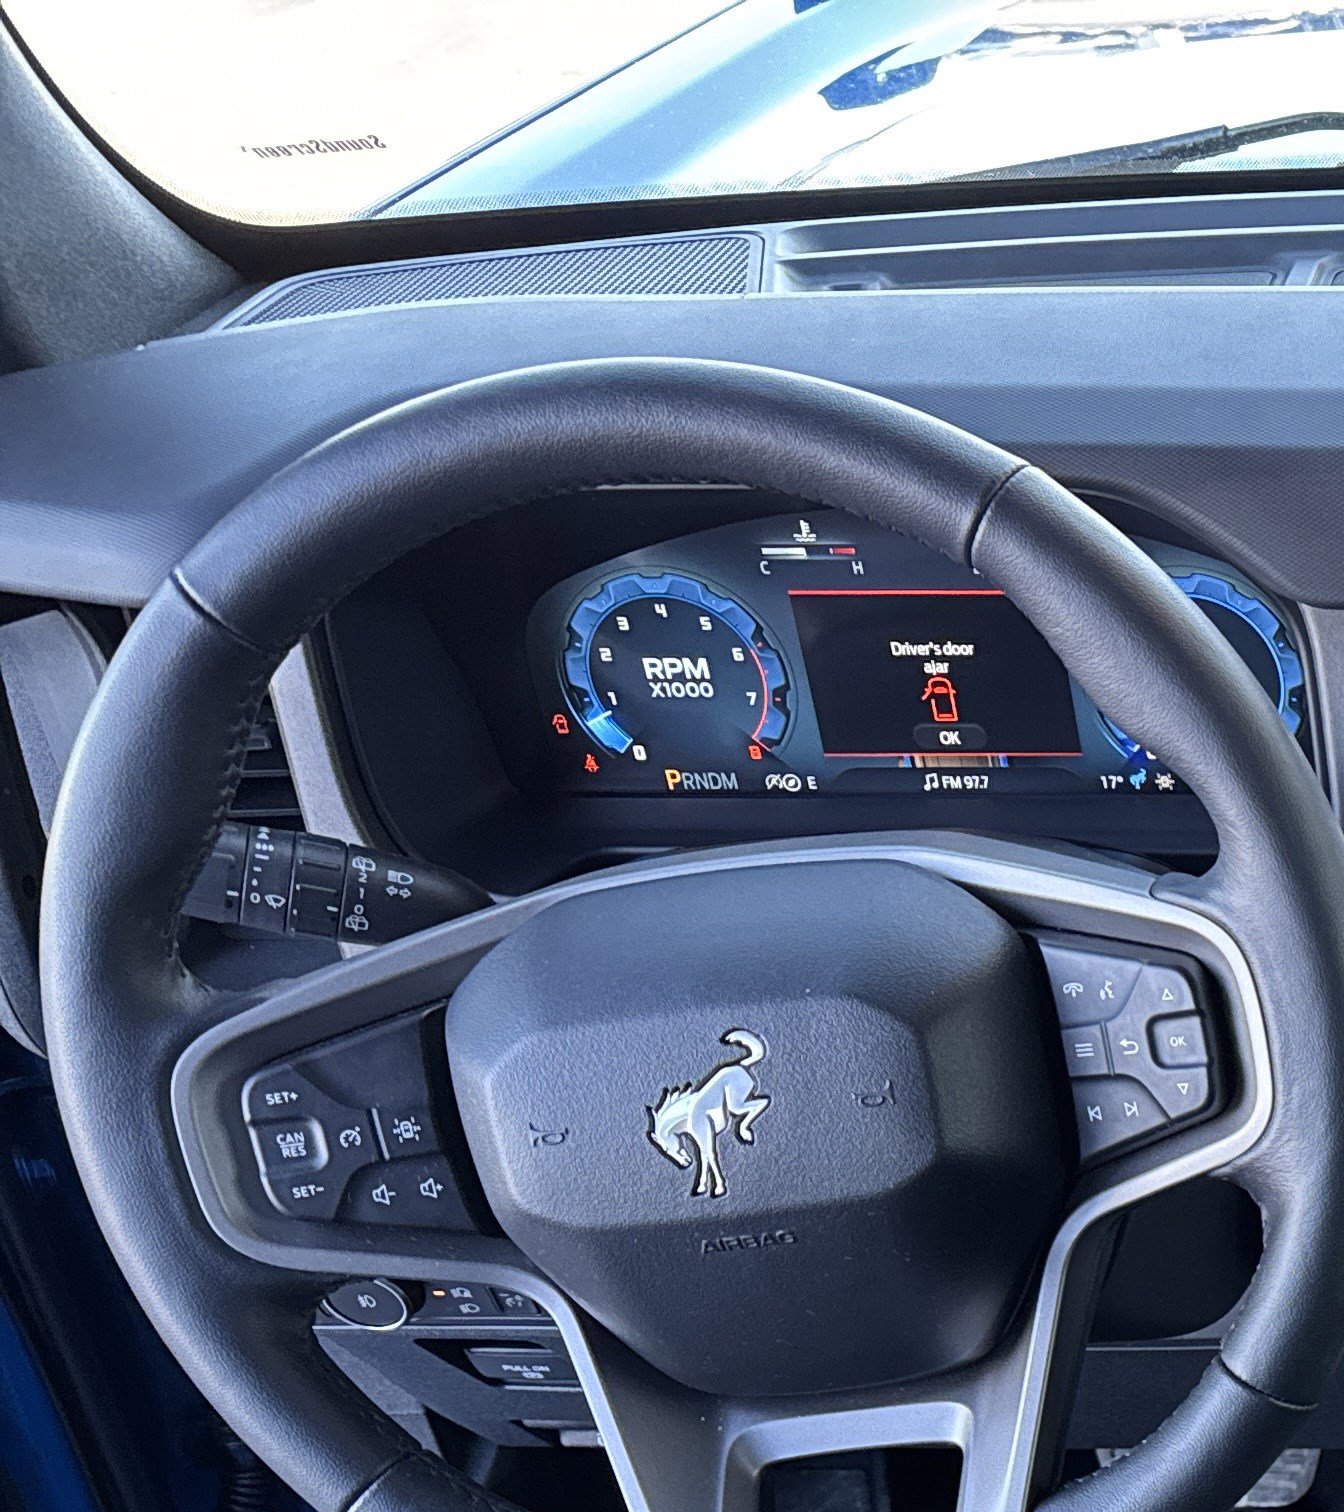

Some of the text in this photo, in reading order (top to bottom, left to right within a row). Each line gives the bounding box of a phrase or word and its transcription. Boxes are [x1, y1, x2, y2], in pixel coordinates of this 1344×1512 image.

[759, 560, 771, 575] C
[852, 560, 864, 575] H
[654, 603, 668, 618] 4
[616, 616, 630, 631] 3
[699, 616, 713, 631] 5
[599, 647, 613, 662] 2
[731, 647, 745, 662] 6
[890, 641, 974, 656] Driver's door
[642, 657, 710, 680] RPM
[923, 660, 949, 675] ajar
[649, 682, 714, 698] X1000
[607, 691, 618, 706] 1
[746, 691, 757, 706] 7
[939, 730, 961, 745] OK
[632, 745, 647, 761] 0
[664, 769, 739, 791] PRNDM
[807, 775, 818, 790] E
[941, 775, 989, 790] FM 97.7
[1100, 775, 1124, 790] 17°
[1169, 1036, 1187, 1047] OK
[265, 1091, 298, 1105] SET+
[276, 1131, 305, 1145] CAN
[282, 1146, 307, 1158] RES
[701, 1230, 798, 1254] AIRBAG
